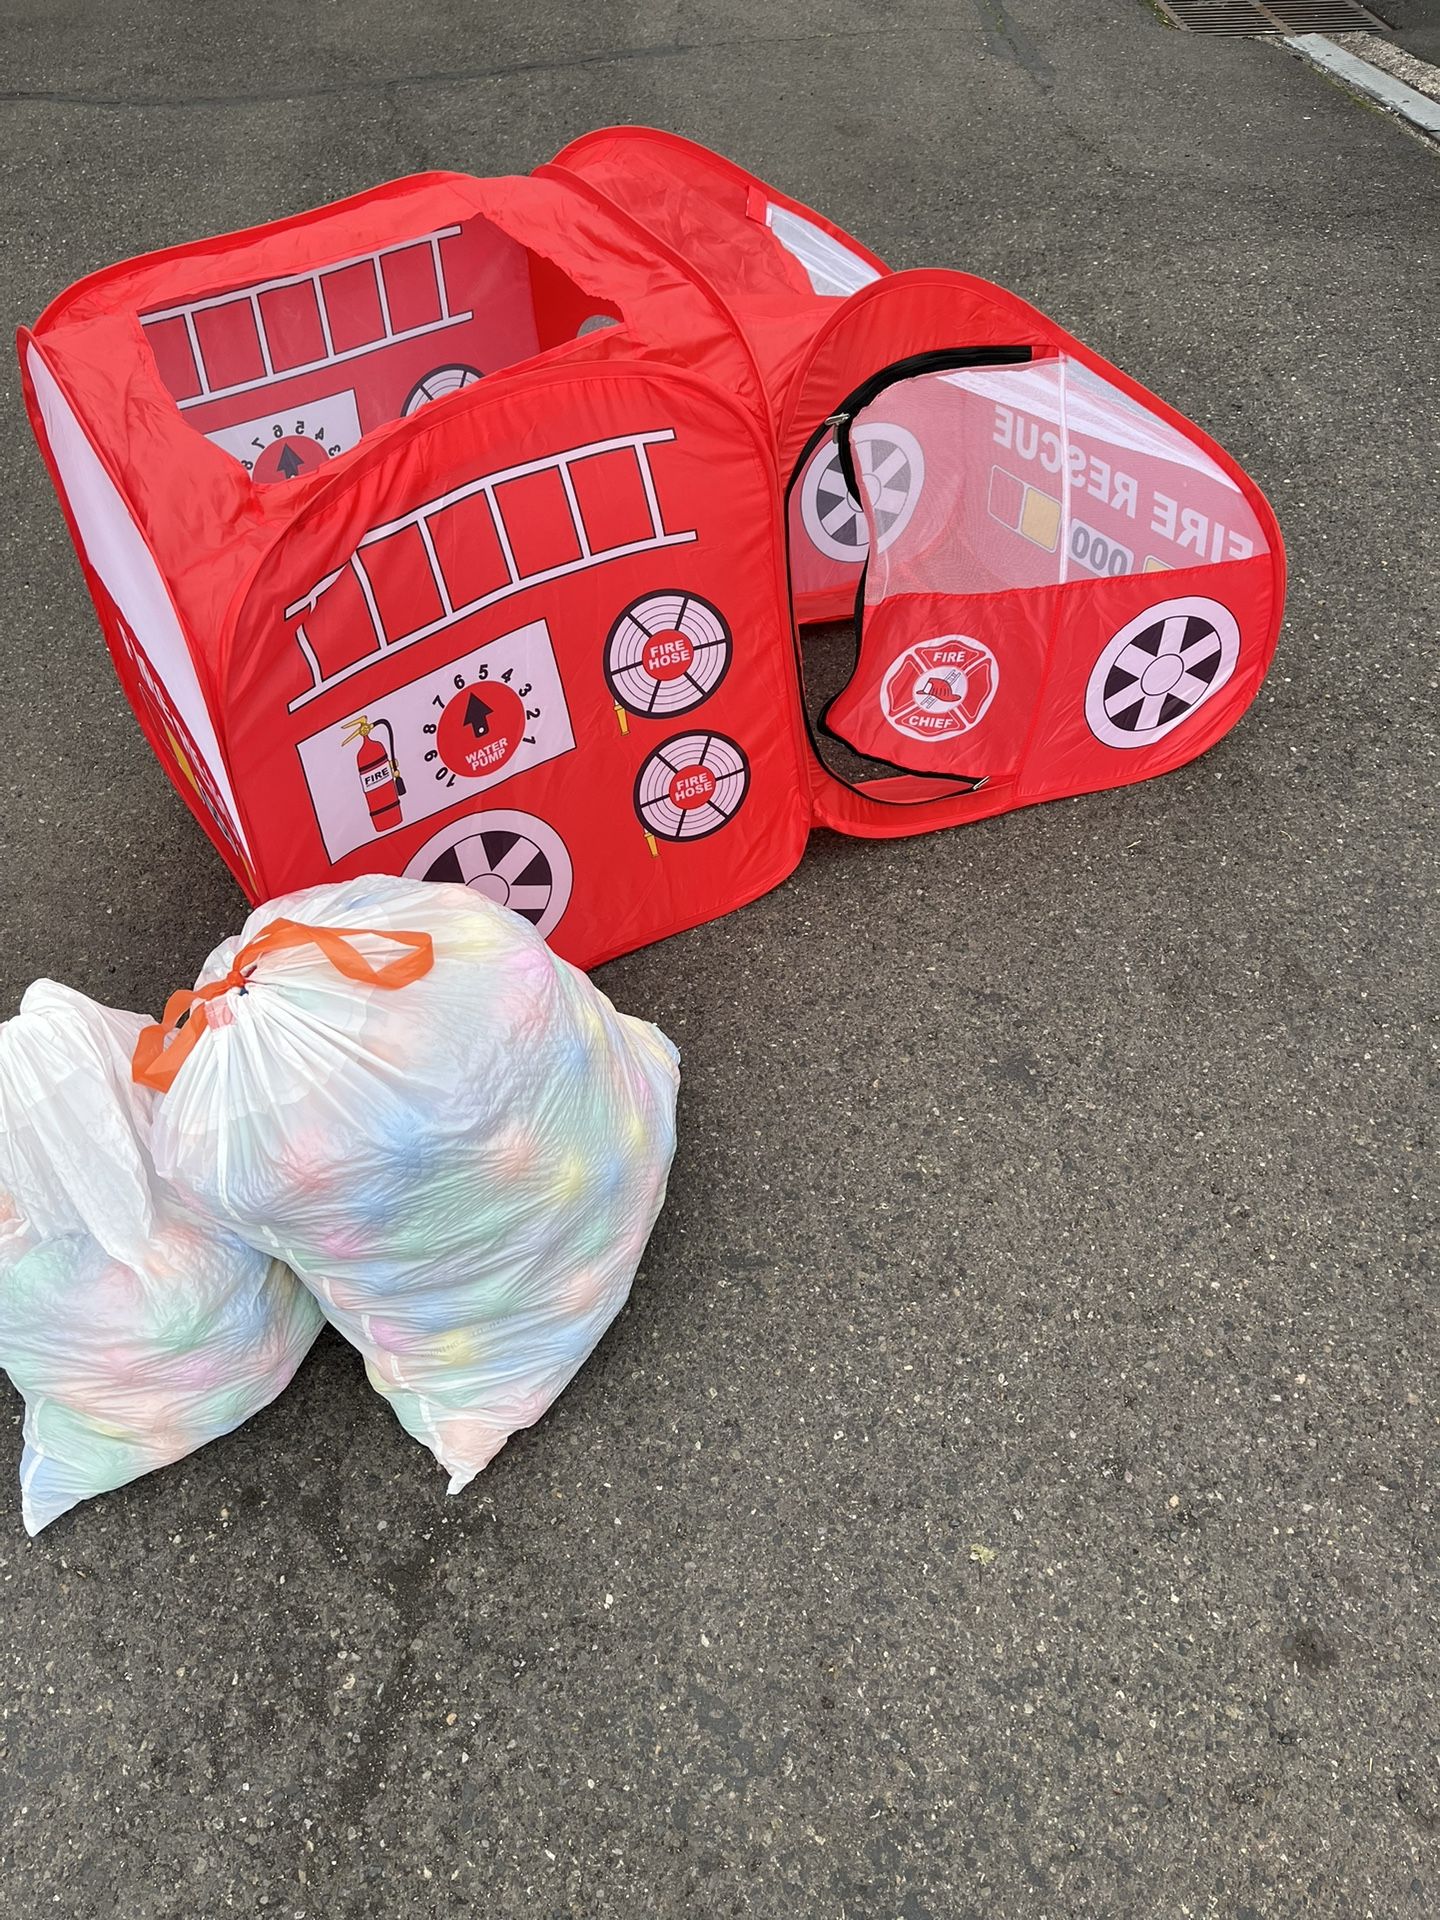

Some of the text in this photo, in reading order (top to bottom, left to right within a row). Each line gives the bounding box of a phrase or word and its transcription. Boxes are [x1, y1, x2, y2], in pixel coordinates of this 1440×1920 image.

[649, 639, 686, 659] FIRE
[932, 651, 967, 663] FIRE
[648, 649, 692, 671] HOSE
[478, 664, 489, 680] 5
[501, 668, 514, 684] 4
[453, 674, 466, 690] 6
[518, 683, 532, 698] 3
[432, 695, 446, 710] 7
[525, 708, 541, 721] 2
[908, 715, 954, 729] CHIEF
[423, 723, 437, 735] 8
[522, 735, 537, 746] 1
[424, 749, 438, 762] 9
[464, 737, 509, 765] WATER
[471, 748, 507, 771] PUMP
[364, 767, 391, 786] FIRE
[675, 772, 709, 791] FIRE
[674, 781, 713, 802] HOSE
